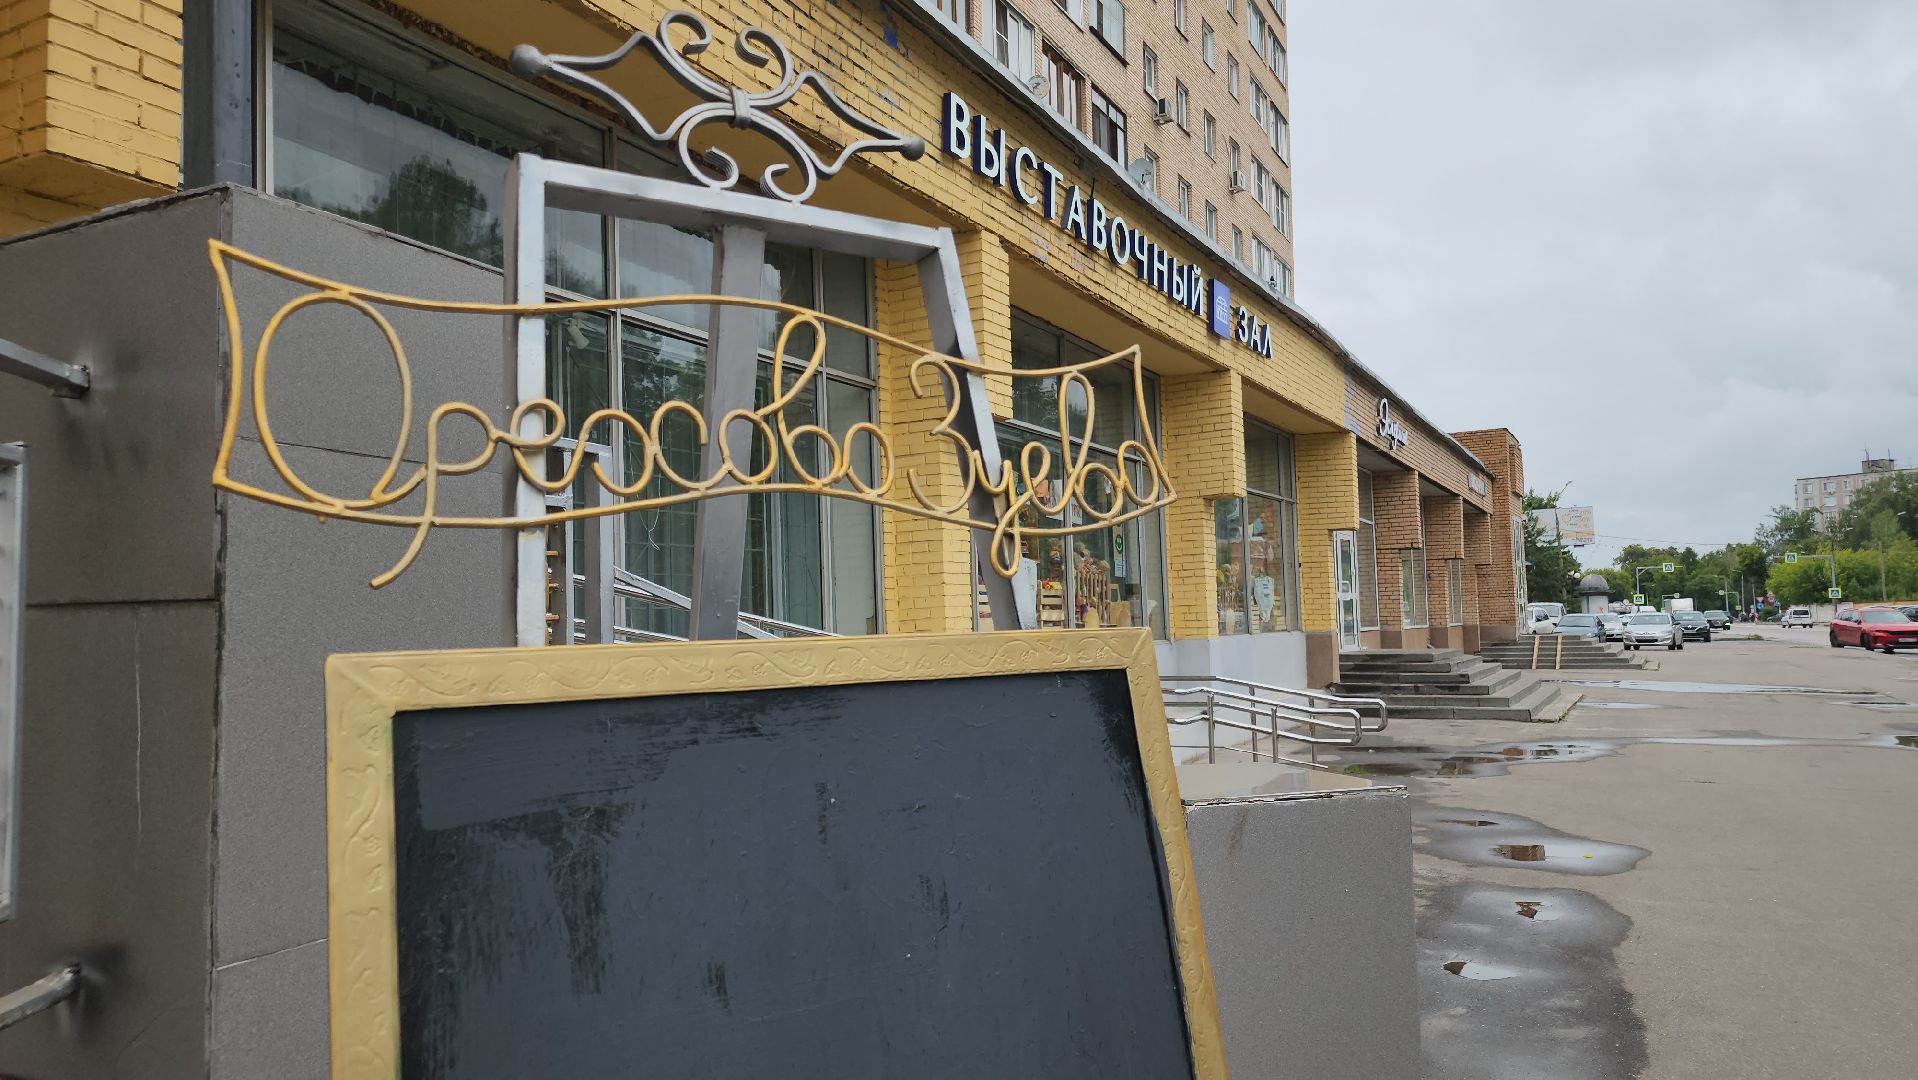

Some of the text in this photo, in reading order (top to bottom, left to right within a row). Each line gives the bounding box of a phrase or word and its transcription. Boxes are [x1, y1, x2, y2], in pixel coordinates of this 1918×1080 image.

[944, 91, 1274, 359] ВЫСТАВОЧНЫЙ ЗАЛ
[253, 289, 1160, 588] Орехово Зуево
